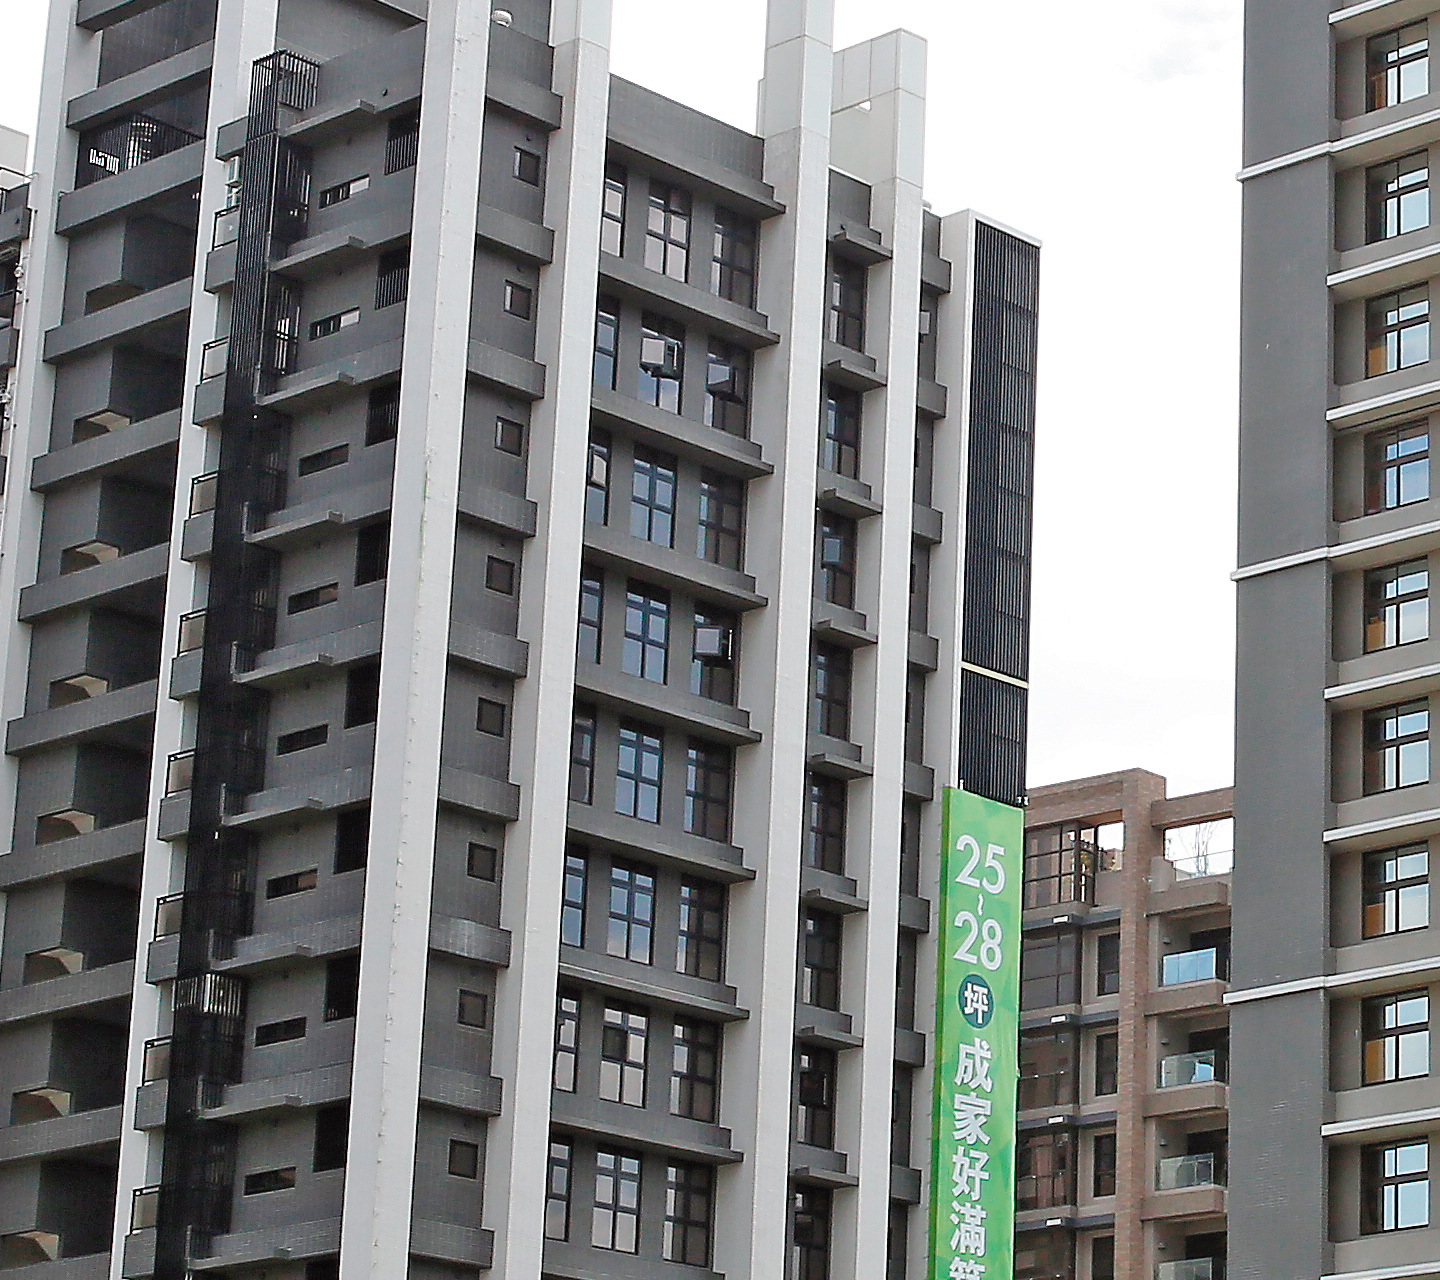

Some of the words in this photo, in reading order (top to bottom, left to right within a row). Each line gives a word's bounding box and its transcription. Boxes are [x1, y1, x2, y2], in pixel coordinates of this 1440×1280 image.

[956, 834, 1007, 896] 25
[953, 911, 1003, 972] 28
[963, 982, 990, 1026] 坪
